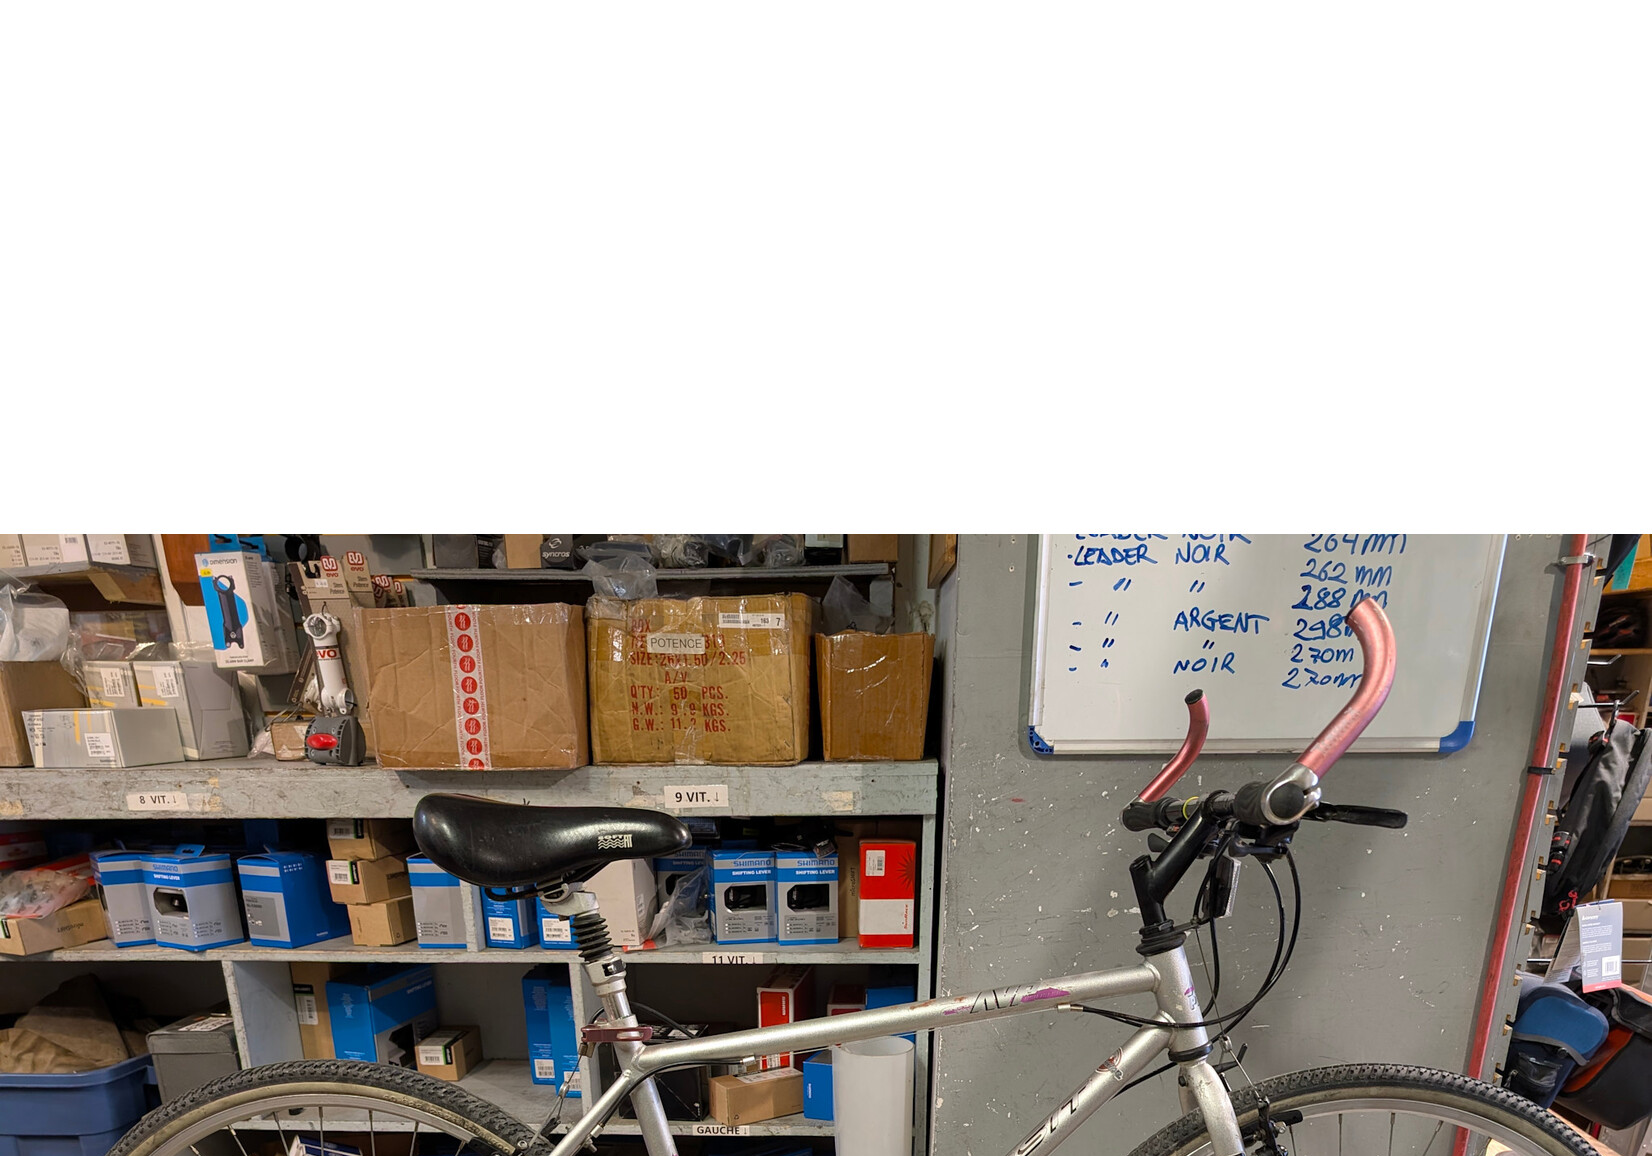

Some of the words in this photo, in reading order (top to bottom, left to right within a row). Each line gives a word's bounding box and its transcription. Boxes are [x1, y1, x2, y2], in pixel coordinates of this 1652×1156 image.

[542, 550, 570, 559] syncros
[1175, 541, 1230, 565] NOIR
[1300, 558, 1348, 585] 262
[1355, 565, 1393, 588] mm
[1291, 584, 1347, 610] 288
[1173, 607, 1270, 634] ARGENT
[650, 637, 702, 649] POTENCE
[1173, 652, 1236, 674] NOIR
[664, 671, 688, 684] A/V
[673, 687, 688, 700] 50
[702, 687, 728, 700] PCS.
[702, 703, 730, 717] KGS.
[704, 719, 731, 733] KGS.
[139, 795, 146, 805] 8
[150, 795, 170, 805] VIT.
[675, 791, 683, 803] 9
[686, 791, 711, 803] VIT.
[152, 863, 179, 873] SHIMANO
[733, 860, 772, 868] SHIMANO
[797, 859, 835, 867] SHIMANO
[712, 955, 720, 964] 11
[722, 955, 749, 964] VIT.
[696, 1126, 740, 1135] GAUCHE
